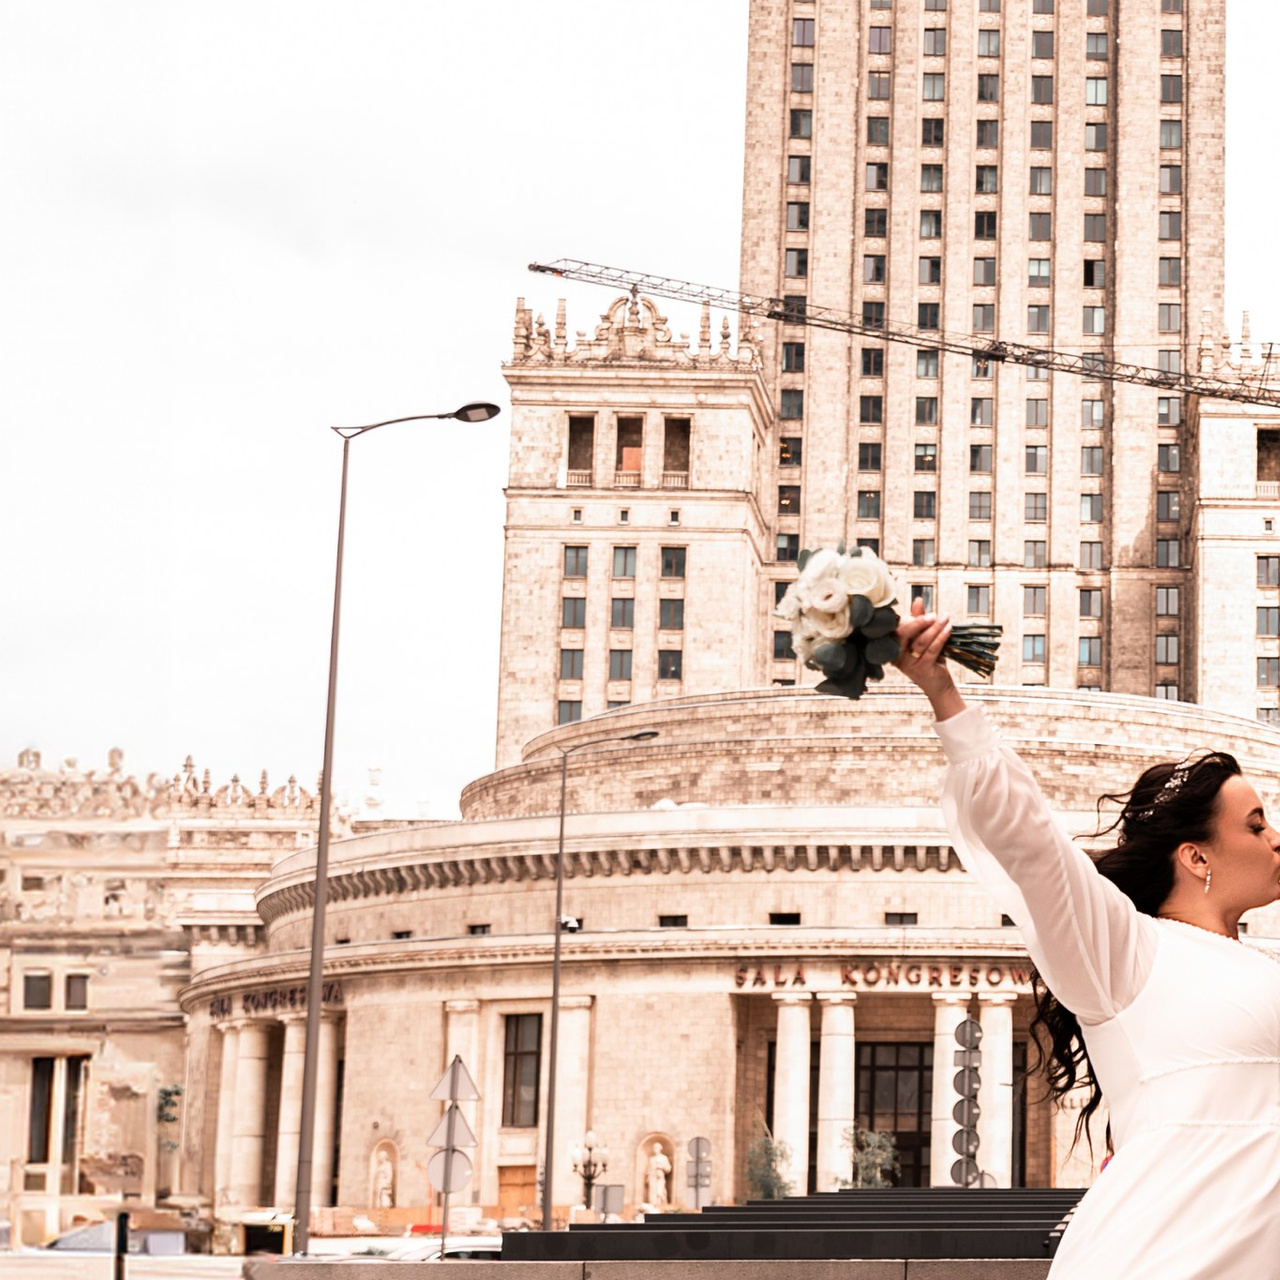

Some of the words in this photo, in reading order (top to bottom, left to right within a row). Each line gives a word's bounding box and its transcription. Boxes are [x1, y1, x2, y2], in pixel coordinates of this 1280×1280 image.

[735, 965, 806, 988] SALA
[841, 964, 1031, 988] KONGRESOW
[243, 982, 343, 1012] KONGRESWA
